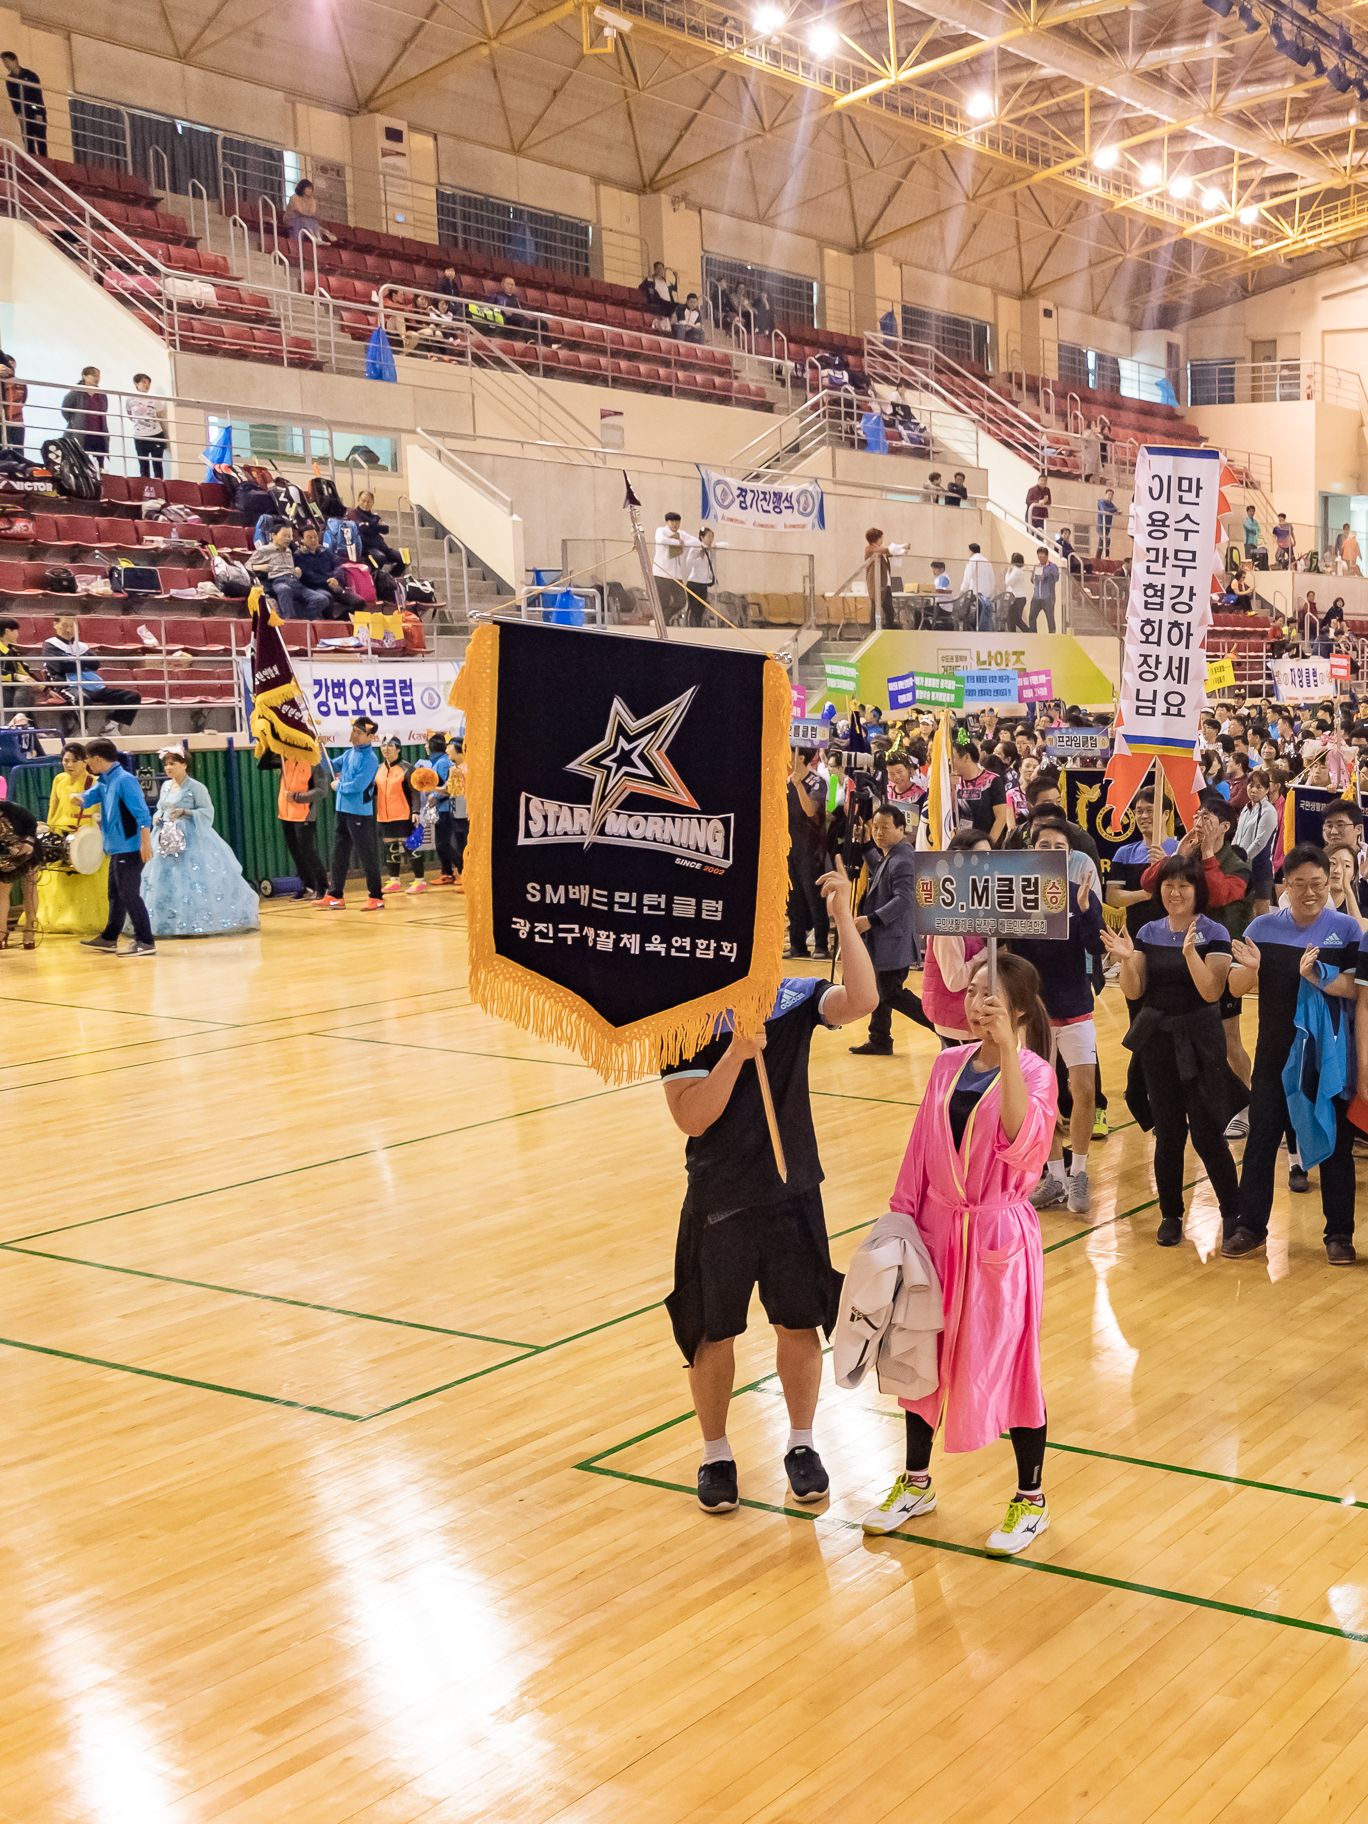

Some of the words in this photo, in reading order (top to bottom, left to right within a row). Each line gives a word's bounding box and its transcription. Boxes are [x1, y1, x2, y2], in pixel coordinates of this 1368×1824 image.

[1135, 474, 1172, 717] 이용만협회장님
[1161, 476, 1203, 717] 만수무강하세요
[313, 678, 416, 717] 강변오전클럽
[528, 798, 591, 836] STAR
[604, 813, 726, 858] MORNING
[674, 857, 702, 870] SINCE
[703, 865, 725, 876] 2002
[920, 880, 933, 904] 필
[1046, 881, 1062, 905] 승
[511, 917, 738, 962] 광진구생활체육연합회
